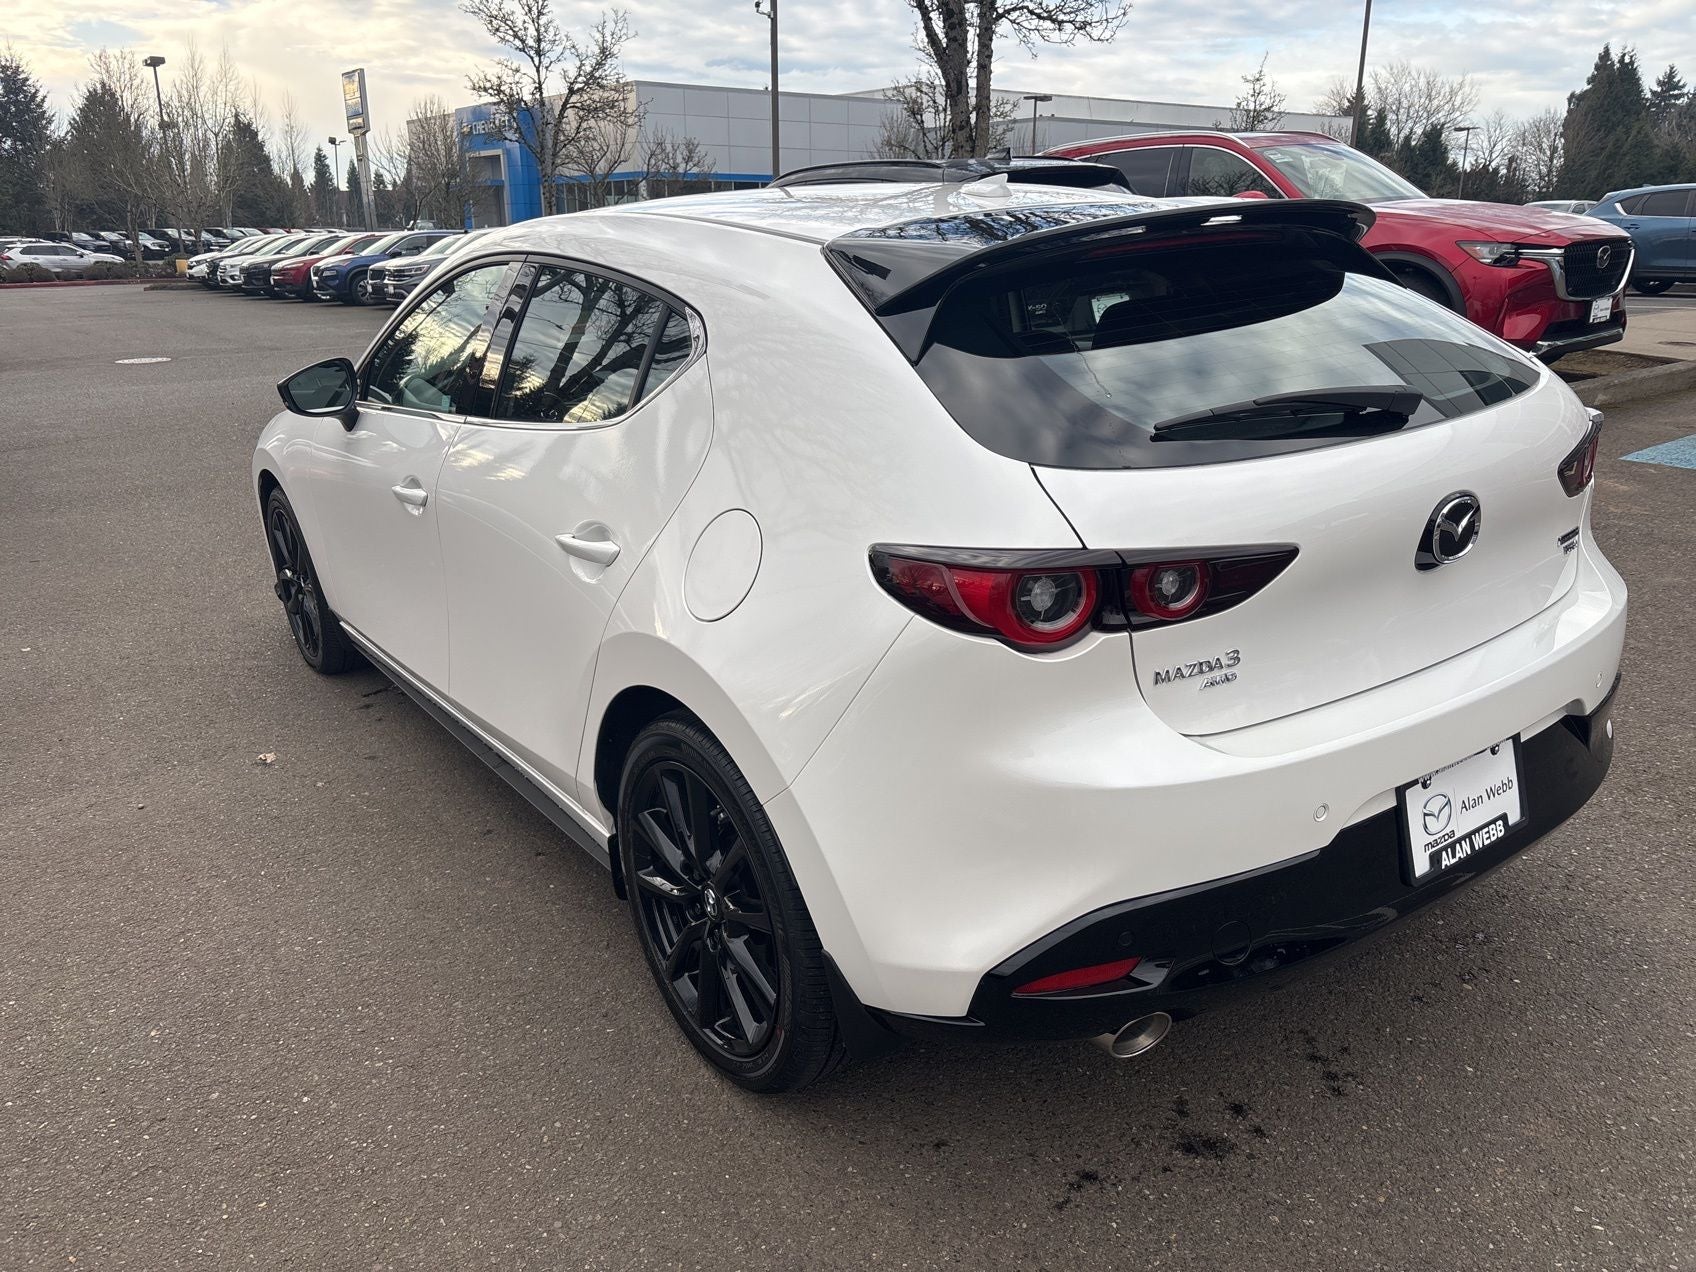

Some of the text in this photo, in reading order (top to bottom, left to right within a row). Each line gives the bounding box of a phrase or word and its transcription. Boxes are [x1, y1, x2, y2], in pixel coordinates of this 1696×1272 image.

[472, 116, 511, 135] CHEVET
[1199, 671, 1238, 691] AWD
[1460, 776, 1514, 815] Alan Webb
[1423, 829, 1456, 853] mazda
[1441, 819, 1505, 870] ALAN WEBB
